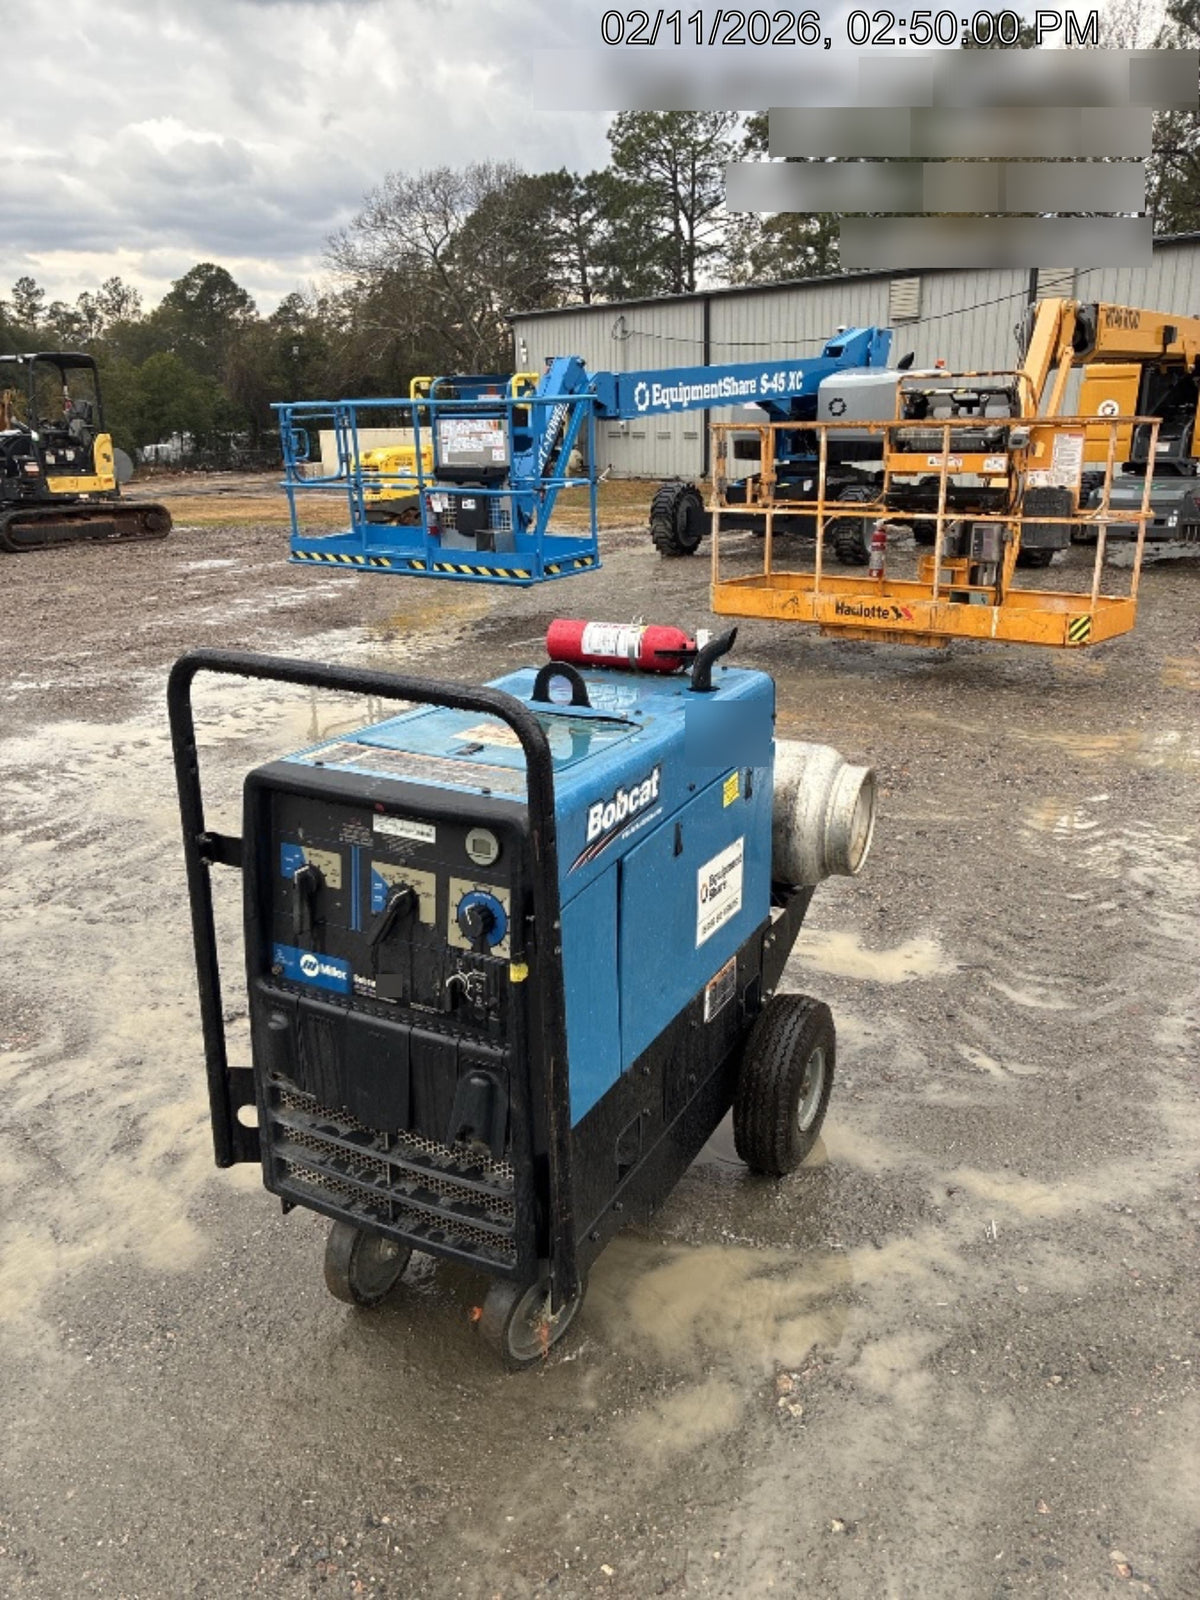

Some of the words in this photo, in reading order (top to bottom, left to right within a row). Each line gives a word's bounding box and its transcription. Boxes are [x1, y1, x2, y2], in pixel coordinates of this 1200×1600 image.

[651, 376, 757, 409] EquipmentShare
[760, 371, 786, 395] S-45
[787, 370, 803, 392] XC
[587, 765, 660, 841] Bobcat
